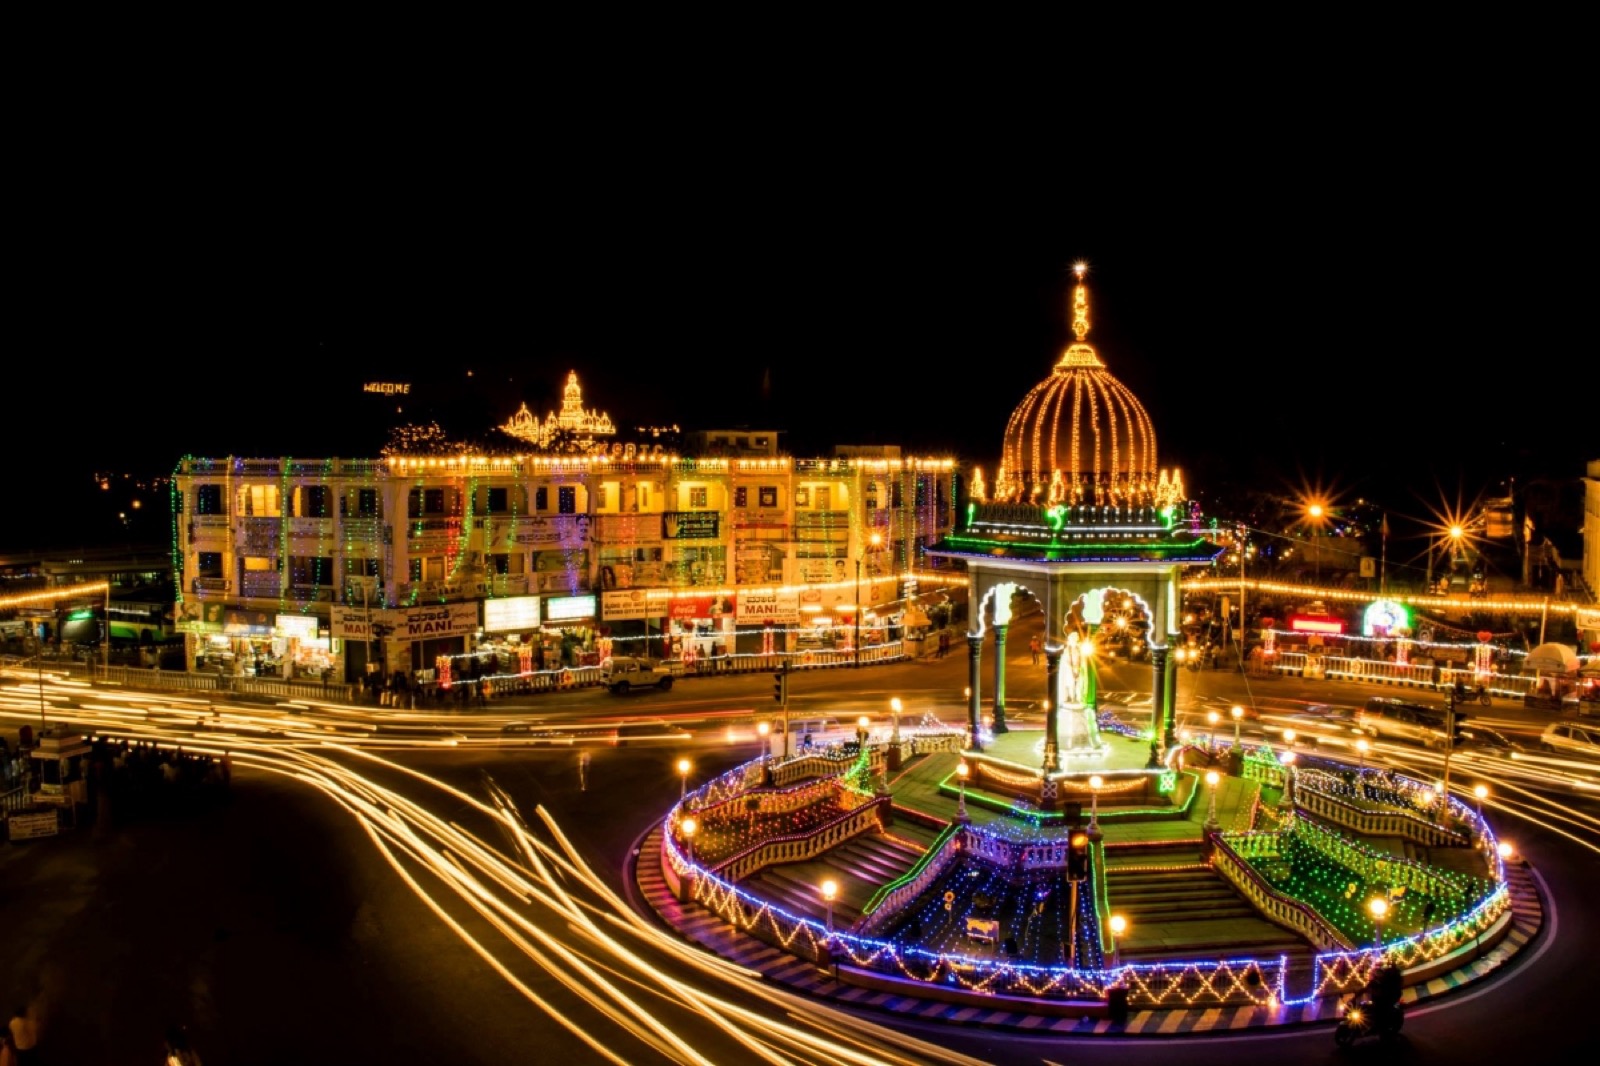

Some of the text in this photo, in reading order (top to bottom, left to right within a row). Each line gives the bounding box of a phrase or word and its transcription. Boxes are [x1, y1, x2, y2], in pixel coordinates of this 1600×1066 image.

[364, 382, 410, 394] WELCOME
[745, 604, 777, 614] MANI
[344, 623, 376, 634] MAN
[408, 620, 452, 634] MANI
